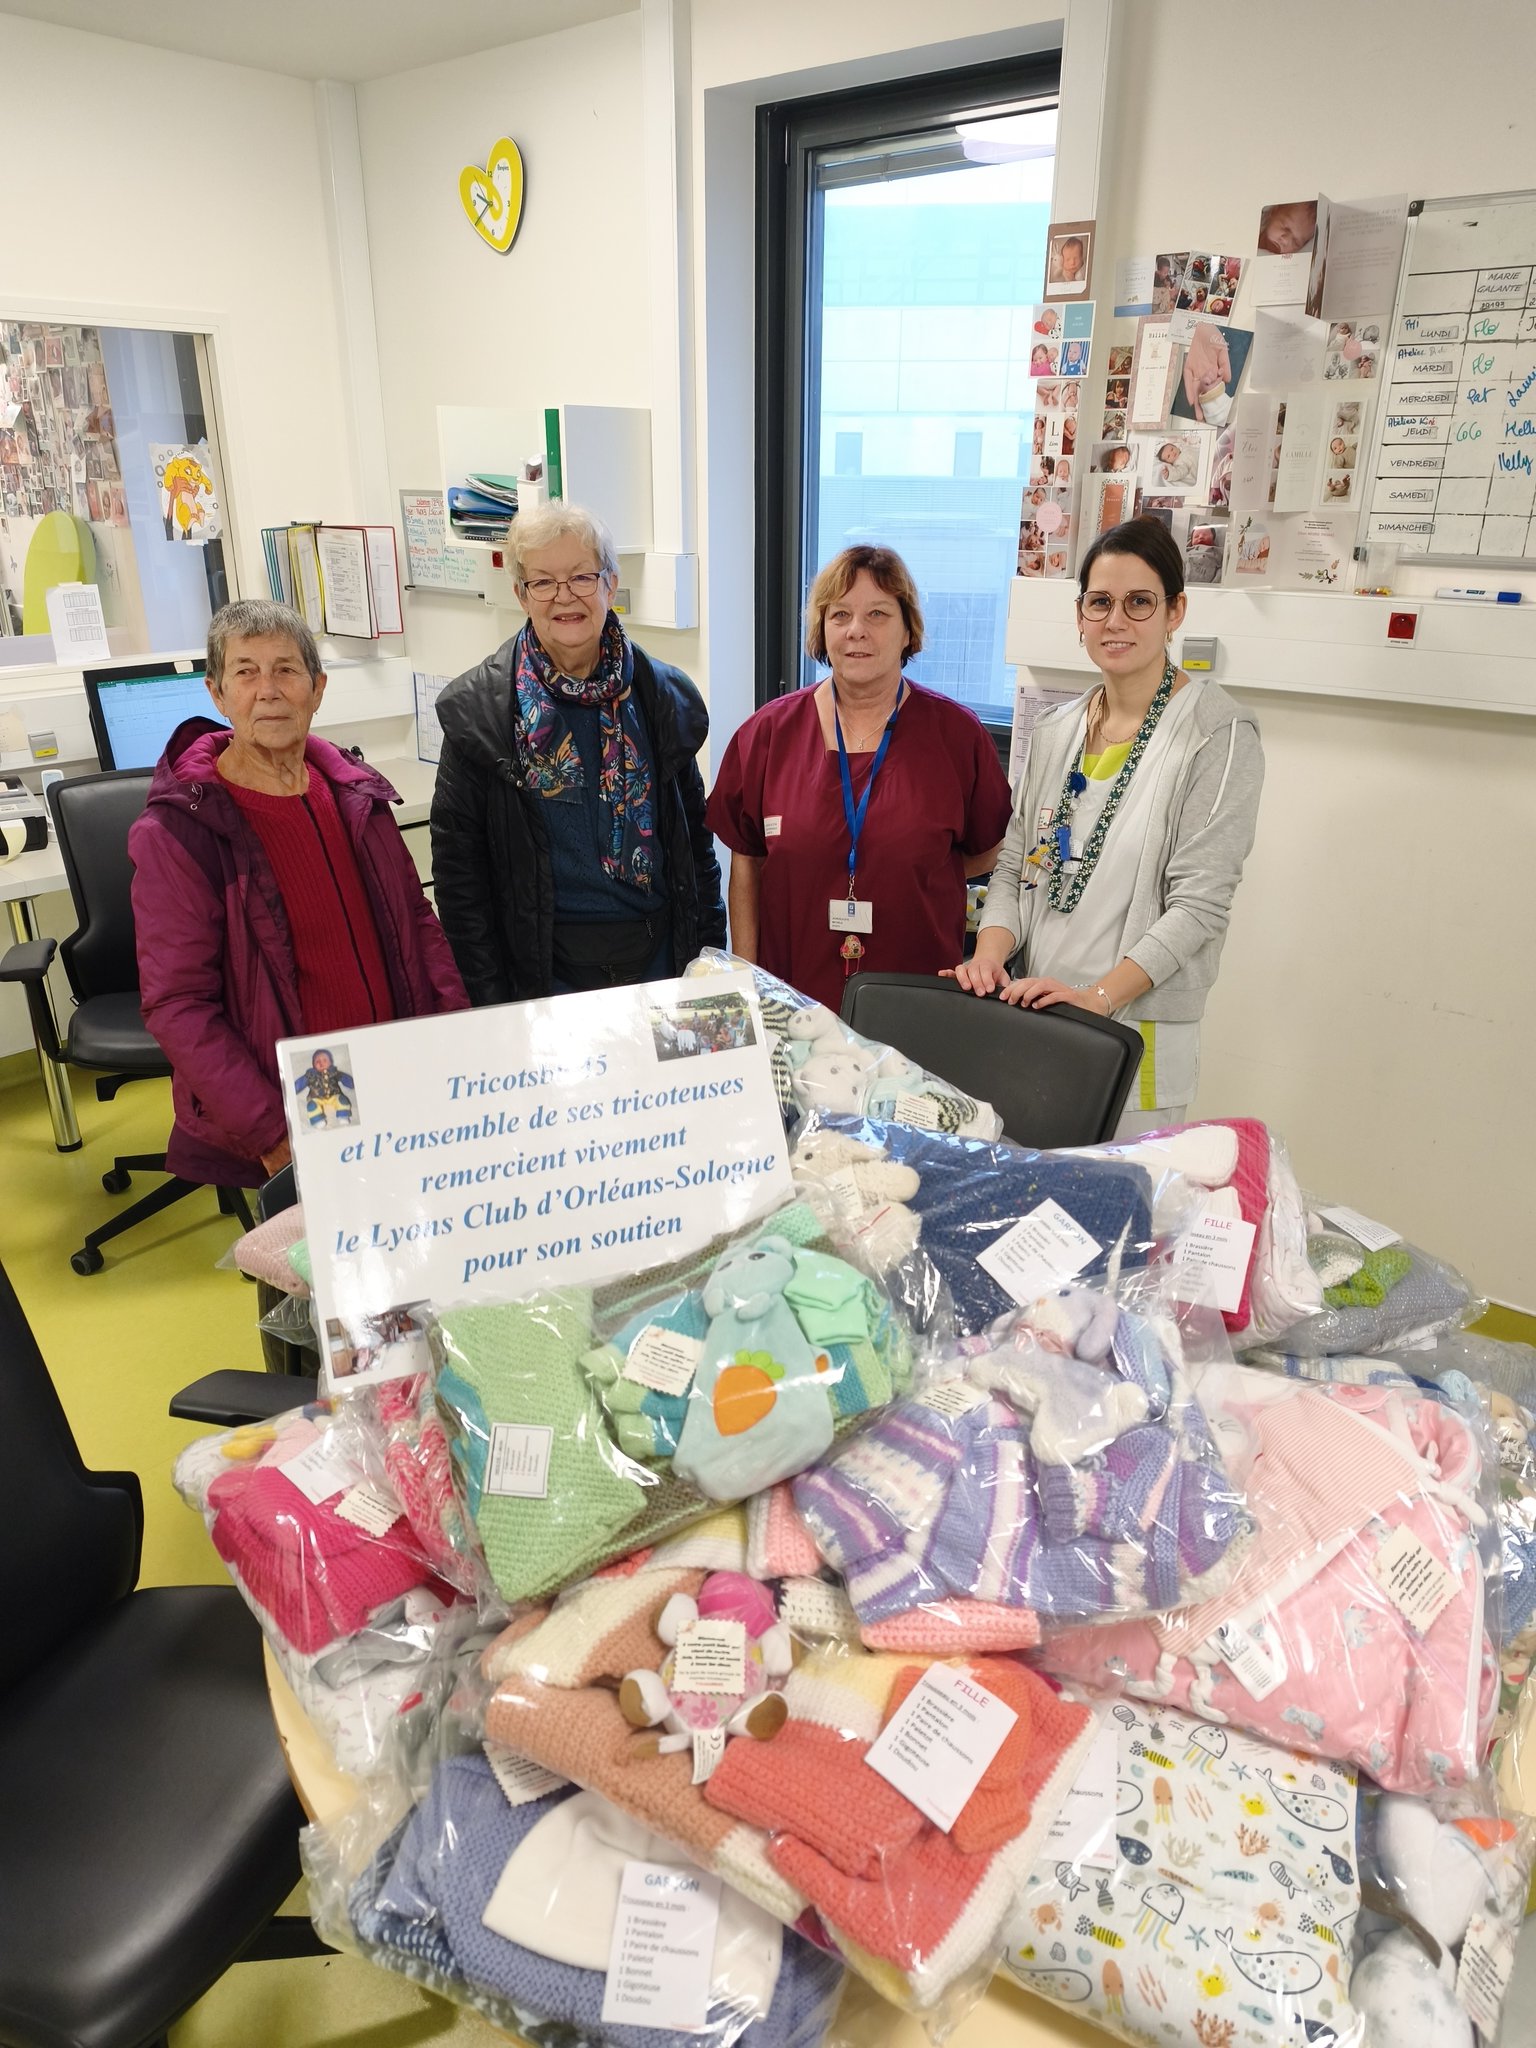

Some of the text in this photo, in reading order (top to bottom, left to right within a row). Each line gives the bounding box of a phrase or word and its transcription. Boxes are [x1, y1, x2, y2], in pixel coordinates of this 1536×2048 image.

[1487, 272, 1521, 281] MARIE
[1477, 284, 1522, 293] GALANTE
[1420, 329, 1451, 338] LUNDI
[1413, 364, 1446, 373] MARDI
[1399, 394, 1450, 403] MERCREDI
[1402, 427, 1432, 438] JEUDI
[1390, 460, 1438, 468] VENDREDI
[1498, 449, 1534, 476] Kelly
[1389, 491, 1426, 499] SAMEDI
[1378, 523, 1428, 532] DIMANCHE
[340, 1140, 365, 1164] et
[528, 1106, 559, 1131] de
[566, 1103, 603, 1124] ses
[612, 1075, 745, 1116] tricoteuses
[421, 1126, 687, 1193] remercient vivement
[336, 1229, 361, 1256] le
[369, 1214, 453, 1249] Lyons
[463, 1196, 528, 1231] Club
[1204, 1218, 1232, 1230] FILLE
[463, 1214, 683, 1283] pour son soutien
[954, 1679, 990, 1708] FILLE
